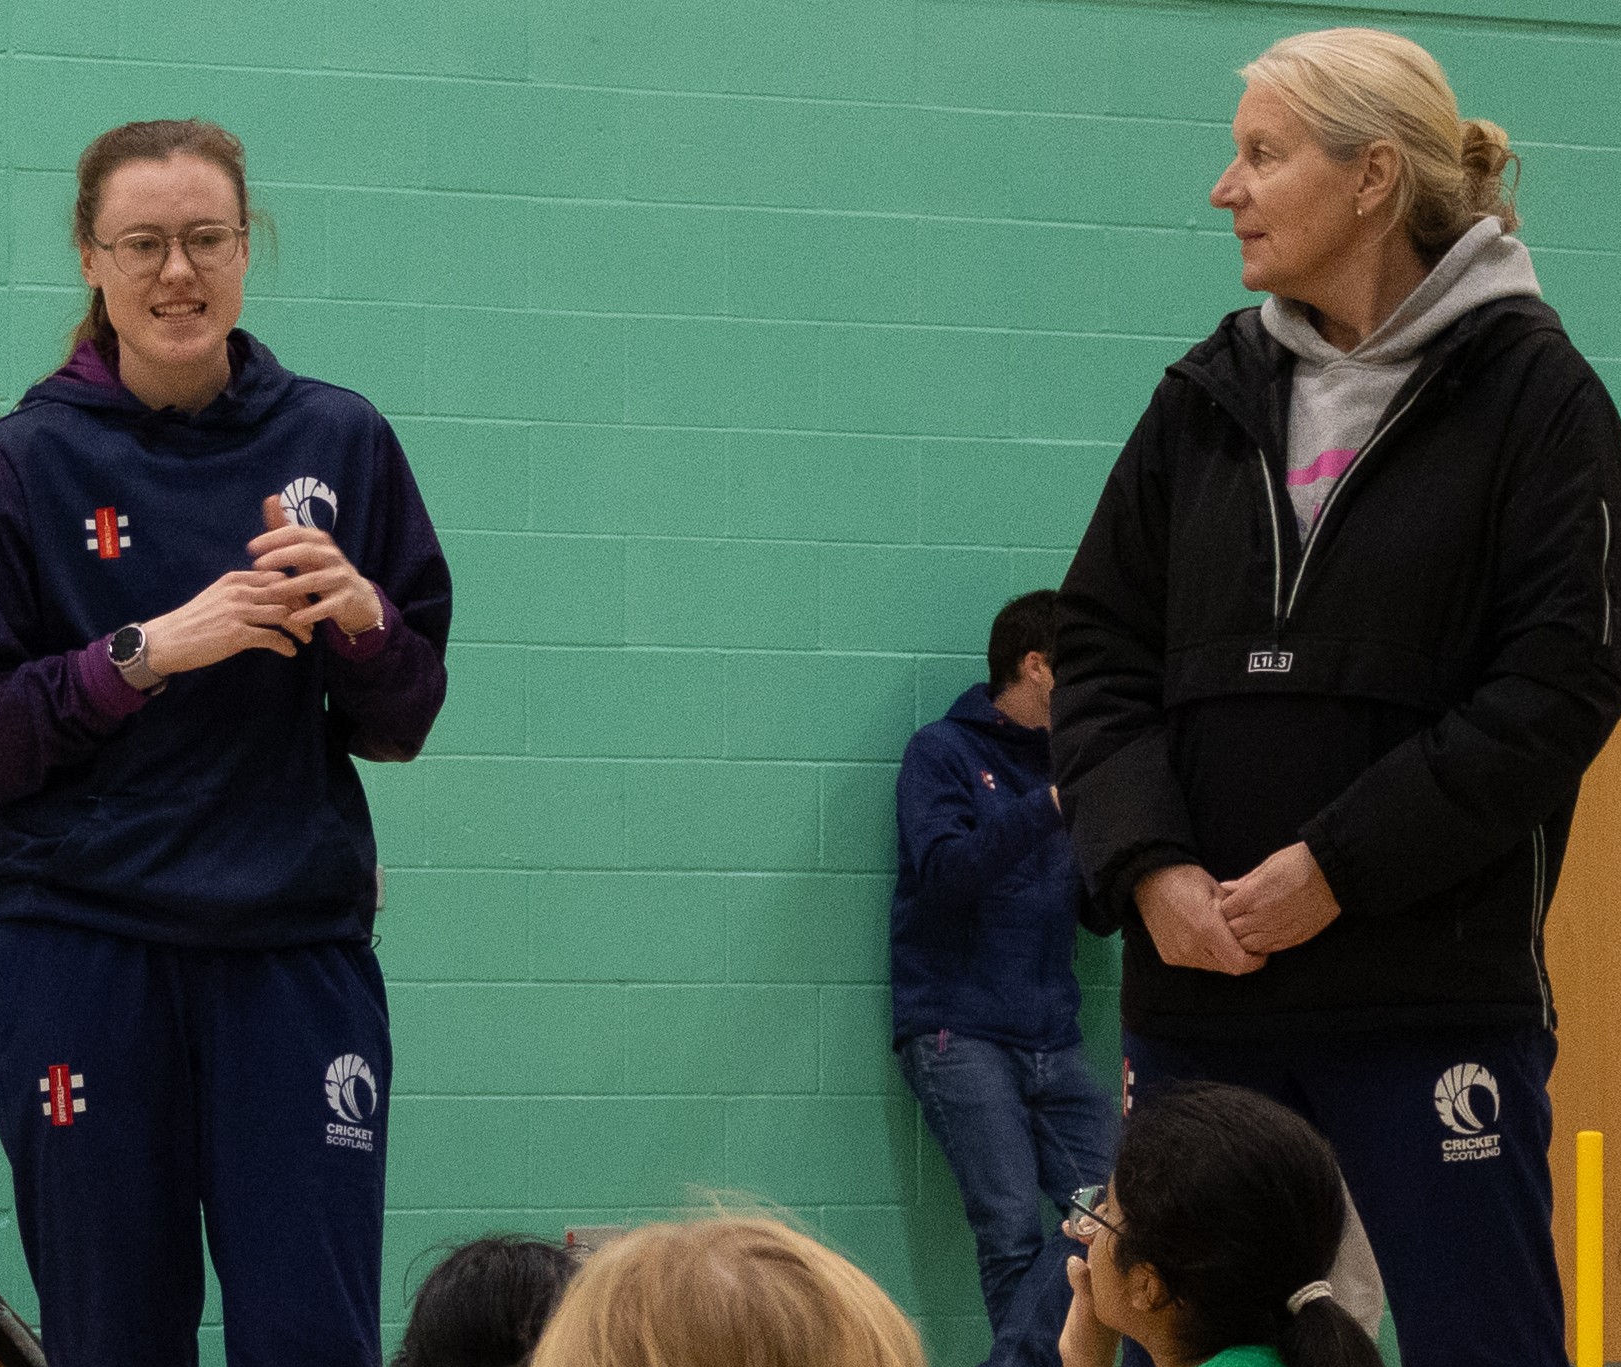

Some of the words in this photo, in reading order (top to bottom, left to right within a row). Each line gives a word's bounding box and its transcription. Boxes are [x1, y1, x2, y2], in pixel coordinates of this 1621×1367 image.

[326, 1123, 373, 1141] CRICKET
[326, 1135, 373, 1152] SCOTLAND
[1442, 1135, 1500, 1151] CRICKET
[1443, 1147, 1500, 1162] SCOTLAND
